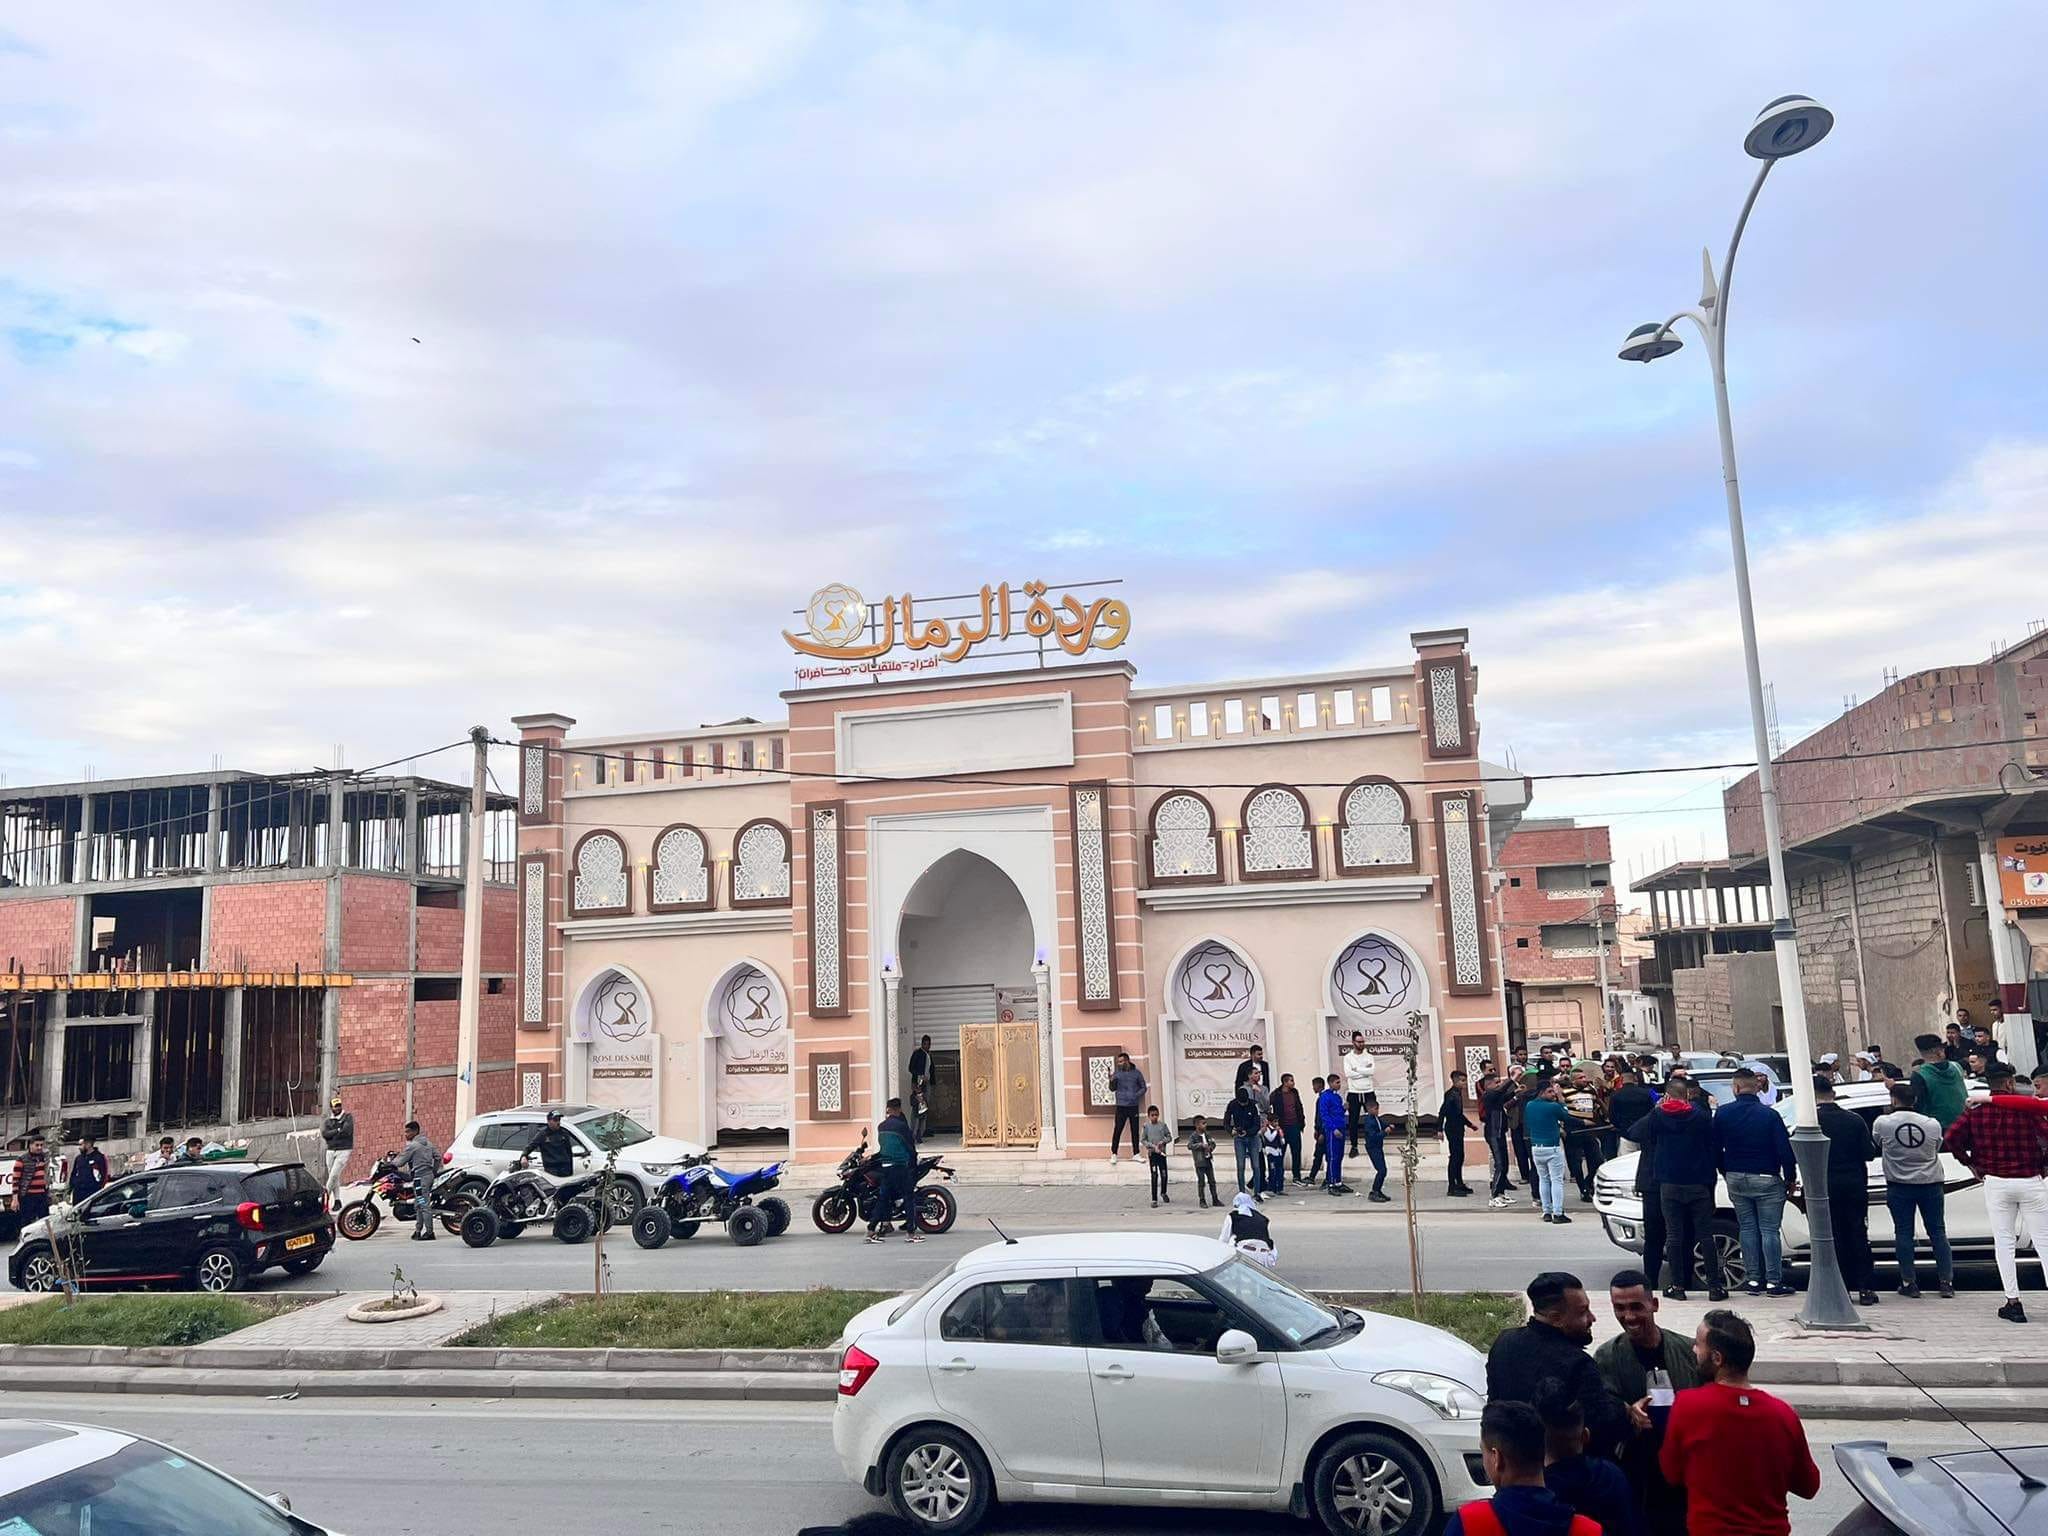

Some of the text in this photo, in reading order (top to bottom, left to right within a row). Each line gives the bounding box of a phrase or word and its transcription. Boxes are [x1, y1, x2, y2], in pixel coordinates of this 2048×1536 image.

[781, 579, 1131, 662] وردة الرمال
[1365, 1028, 1383, 1036] DES
[1184, 1033, 1207, 1042] ROSE
[593, 1055, 613, 1063] ROSE
